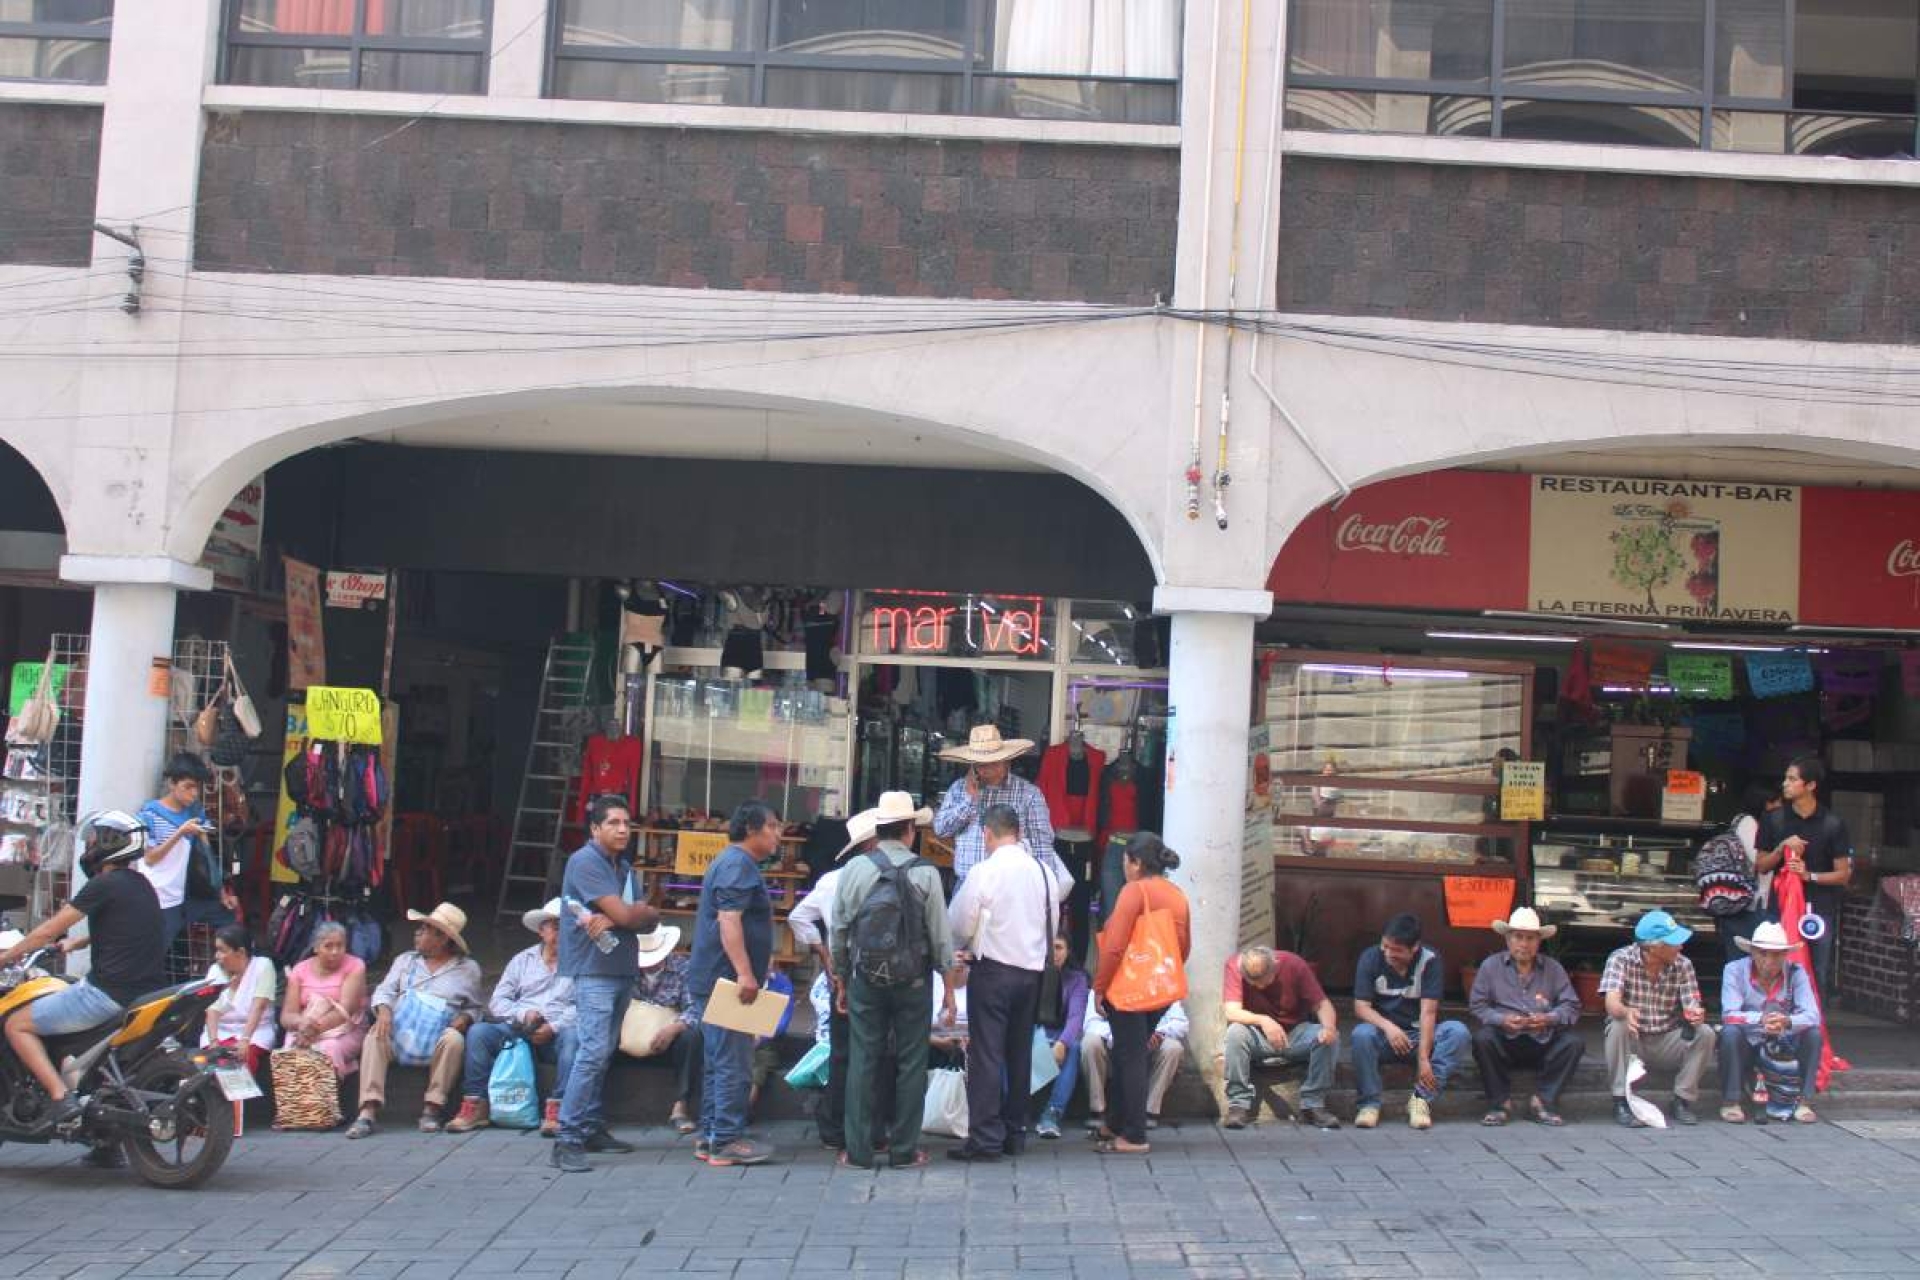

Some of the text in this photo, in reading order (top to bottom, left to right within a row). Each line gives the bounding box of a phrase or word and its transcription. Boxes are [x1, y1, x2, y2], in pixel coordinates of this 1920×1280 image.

[1540, 477, 1793, 502] RESTAURANT-BAR
[1336, 513, 1450, 555] Coca-Cola
[1538, 599, 1793, 622] LA ETERNA PRIMAVERA
[311, 690, 376, 714] CANGURO
[323, 711, 357, 739] $70
